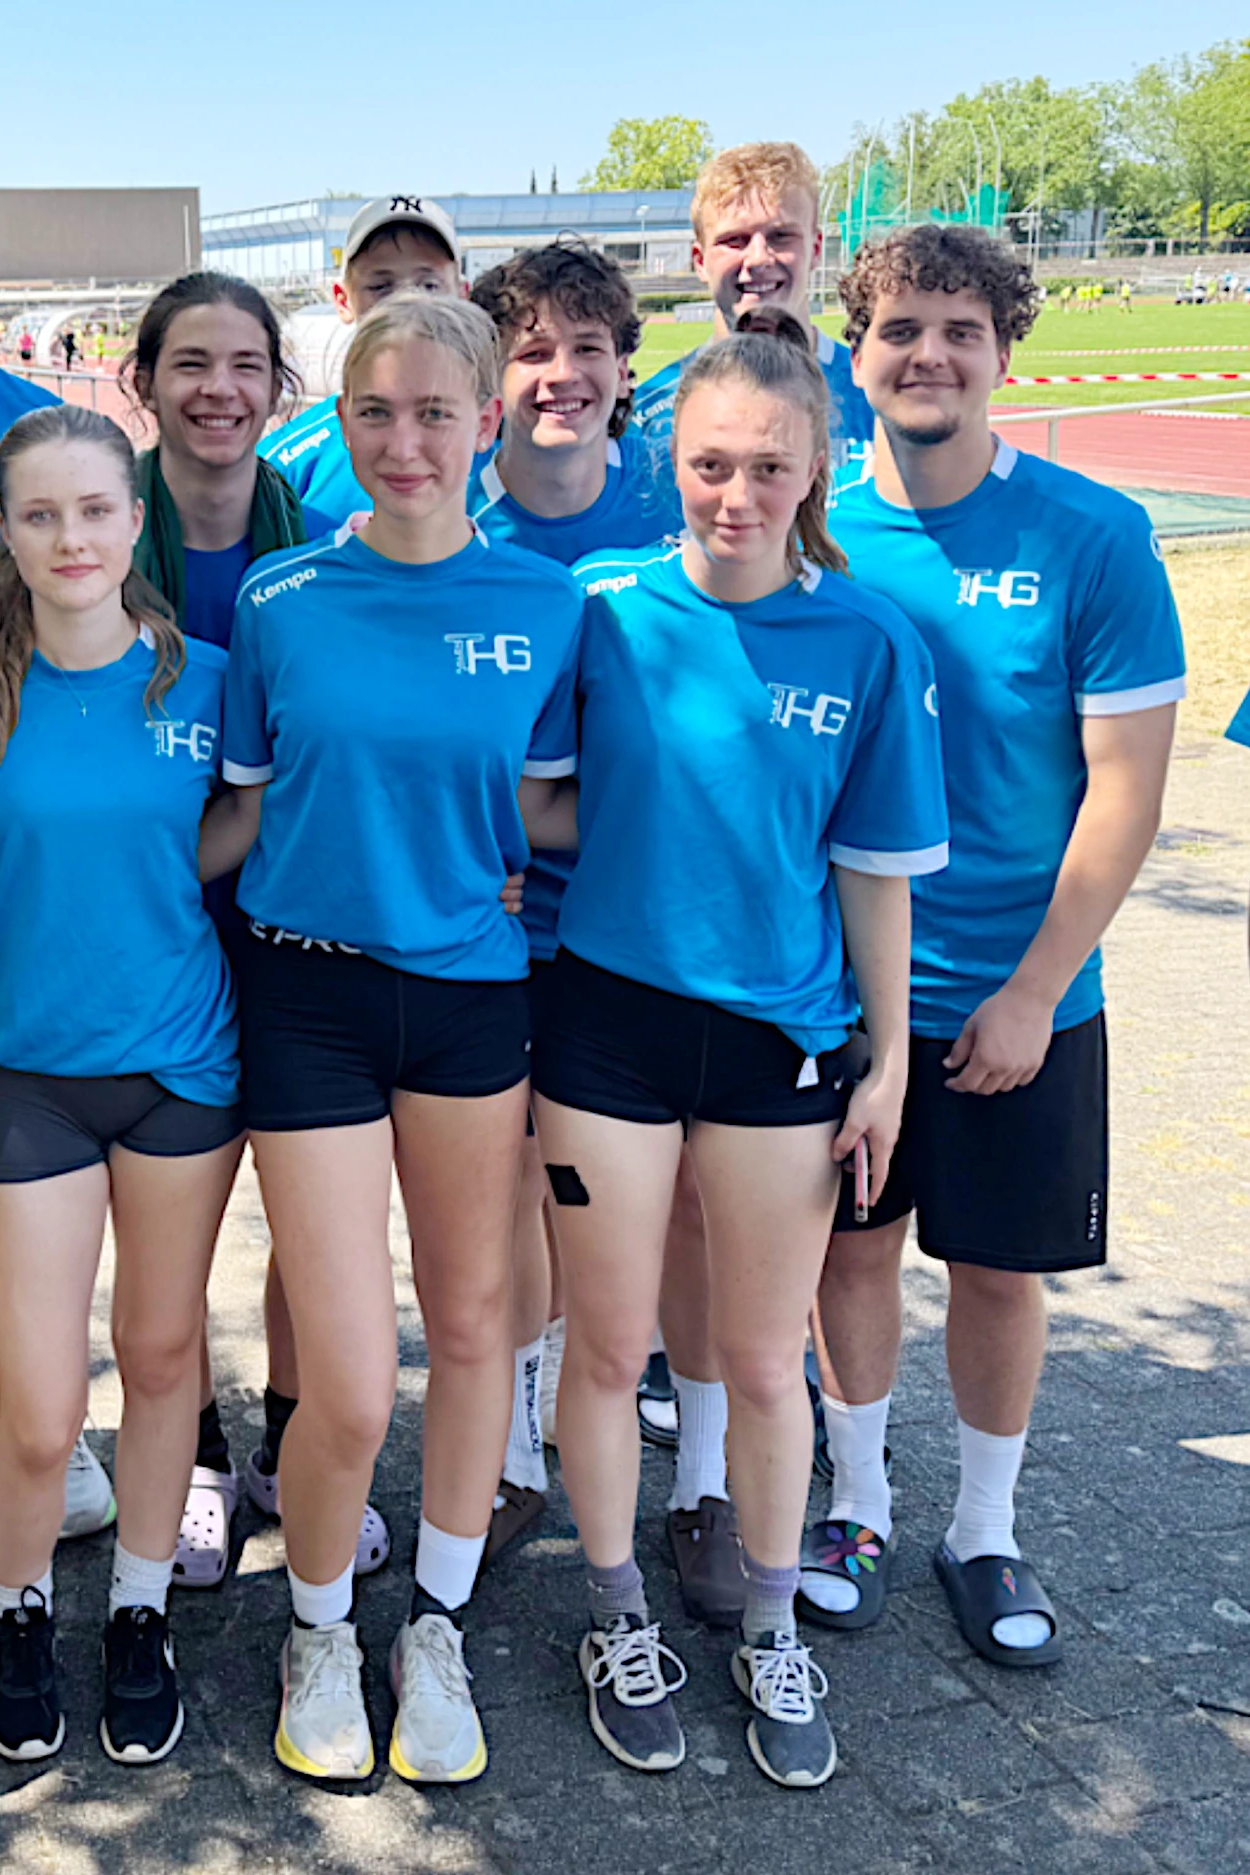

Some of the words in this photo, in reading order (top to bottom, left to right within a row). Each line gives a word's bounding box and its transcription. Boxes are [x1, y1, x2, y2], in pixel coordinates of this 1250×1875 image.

[277, 426, 331, 467] Kempa
[251, 567, 317, 608] Kempa
[585, 572, 638, 596] empa
[953, 567, 1041, 609] THG
[444, 633, 531, 674] THG
[767, 682, 852, 735] THG
